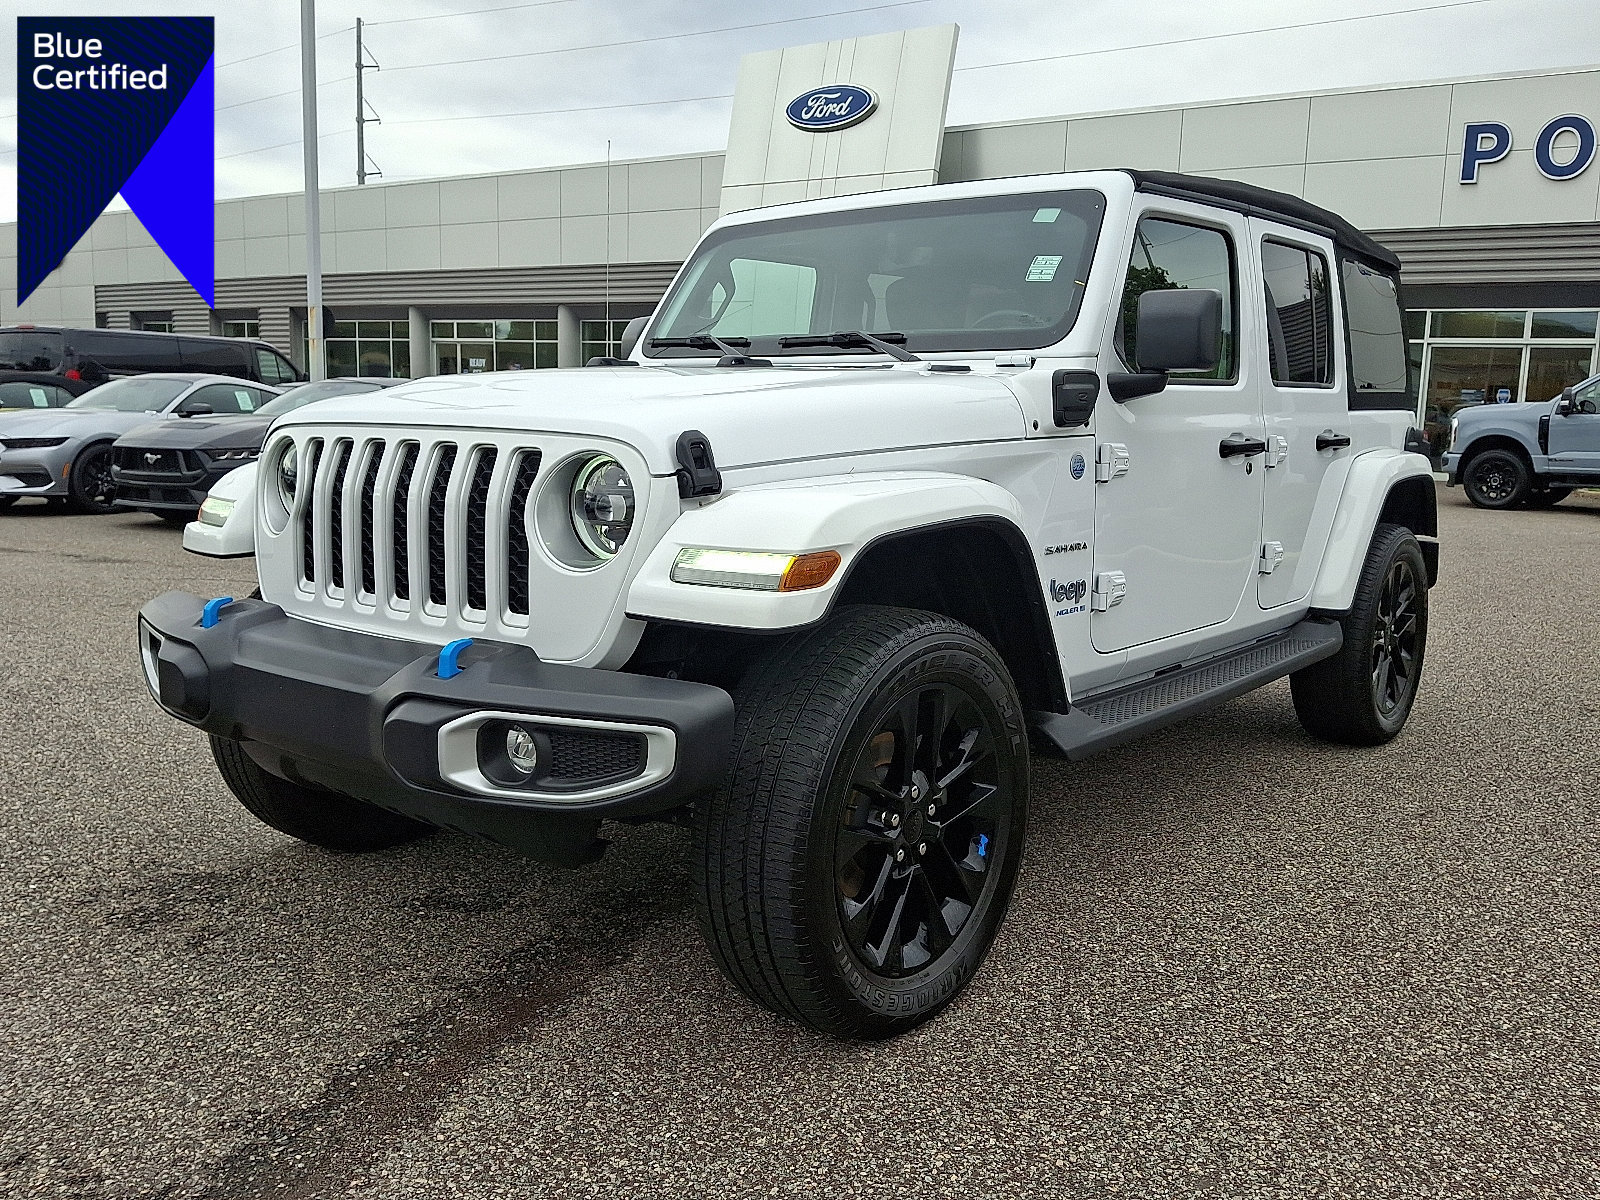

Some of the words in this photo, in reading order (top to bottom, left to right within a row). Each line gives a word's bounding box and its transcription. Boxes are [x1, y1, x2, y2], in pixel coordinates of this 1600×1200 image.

[801, 92, 854, 120] Ford
[1460, 112, 1597, 184] PO
[1044, 541, 1088, 555] SAHARA
[1050, 578, 1087, 604] Jeep
